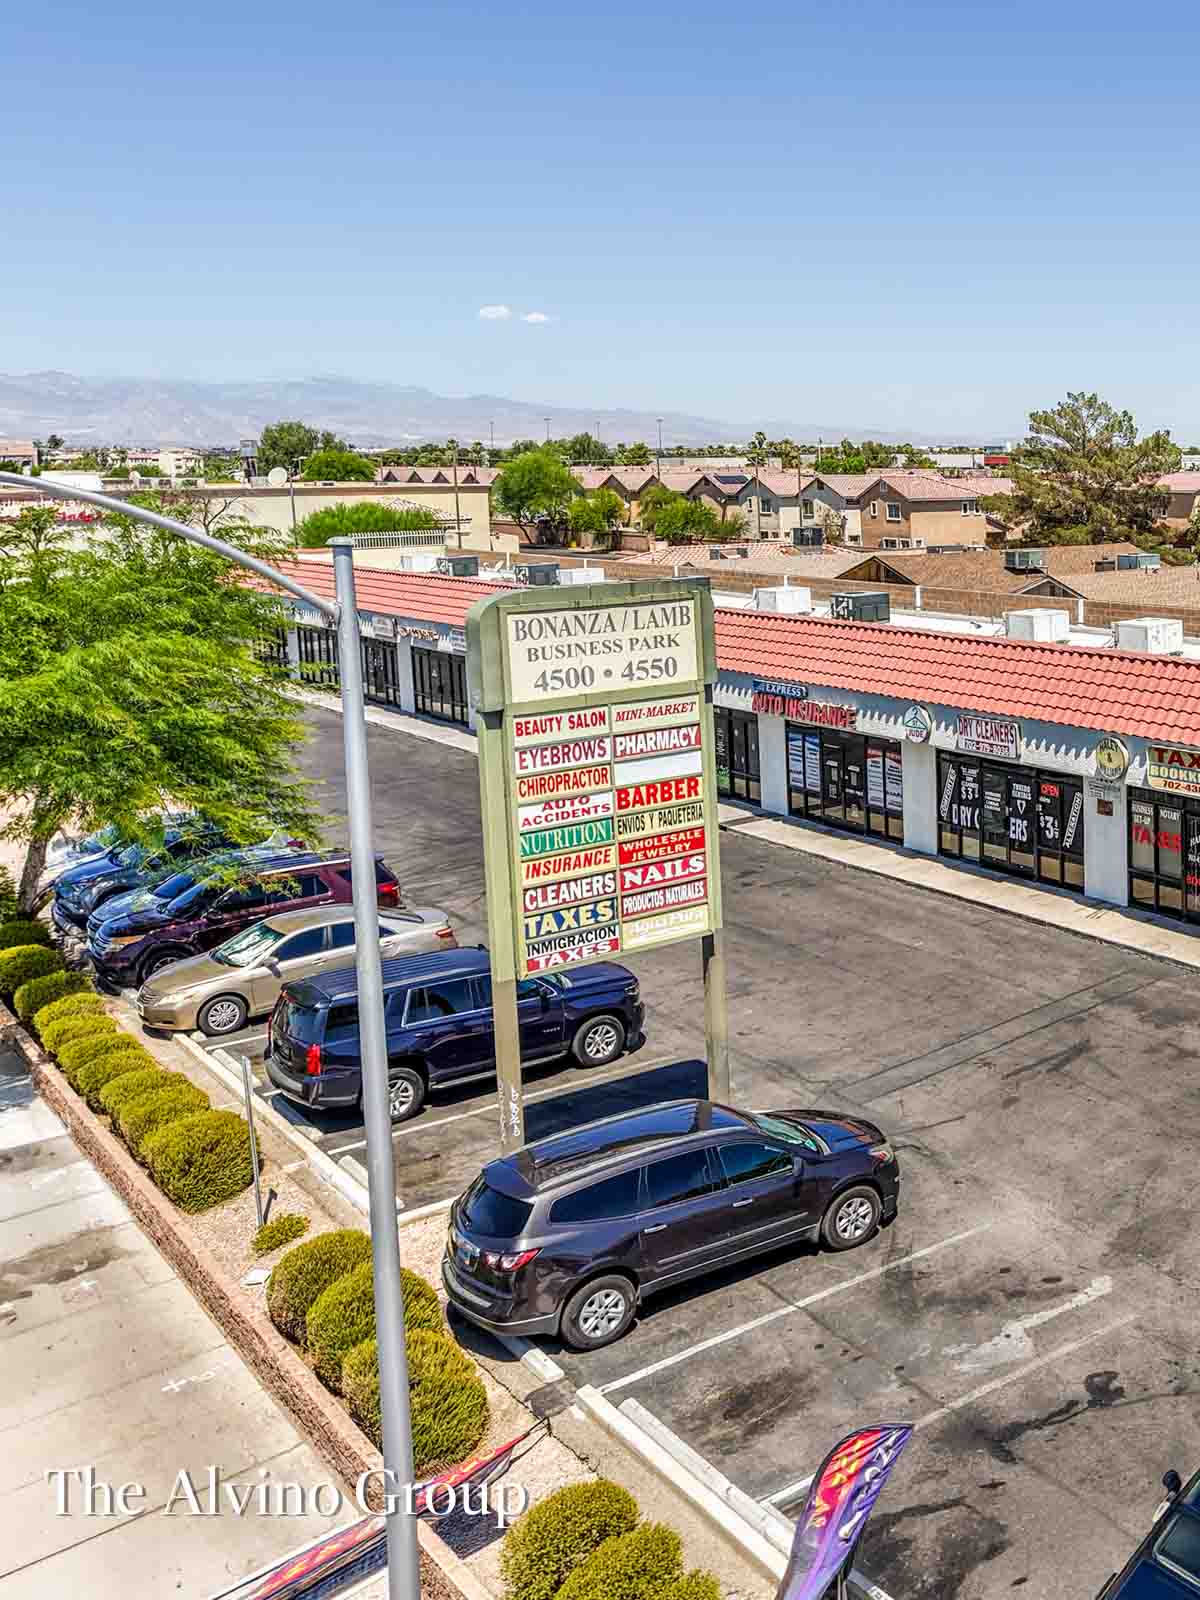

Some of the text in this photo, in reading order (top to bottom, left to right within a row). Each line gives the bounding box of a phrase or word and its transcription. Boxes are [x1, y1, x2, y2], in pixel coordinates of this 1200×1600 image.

[513, 610, 617, 642] BONANZA
[633, 605, 691, 631] LAMB
[527, 633, 680, 662] BUSINESS PARK
[534, 656, 678, 692] 4500 4550
[752, 693, 783, 717] AUTO
[766, 684, 801, 697] EXPRESS
[515, 710, 606, 737] BEAUTY SALON
[959, 718, 1015, 745] DRY CLEANERS
[518, 737, 607, 770] EYEBROWS
[615, 726, 699, 757] PHARMACY
[518, 767, 609, 798] CHIROPRACTOR
[616, 777, 700, 810] BARBER
[521, 803, 611, 828] ACCIDENTS
[542, 795, 591, 812] AUTO
[617, 805, 703, 835] ENVIOS Y PAQUETERIA
[520, 821, 607, 856] NUTRITION
[622, 829, 702, 852] WHOLESALE
[631, 841, 692, 862] JEWELRY
[525, 848, 611, 879] INSURANCE
[624, 855, 705, 888] NAILS
[525, 873, 615, 910] CLEANERS
[623, 881, 705, 914] PRODUCTOS NATURALES
[525, 900, 613, 938] TAXES
[527, 927, 617, 957] INMIGRACION
[534, 941, 611, 969] TAXES
